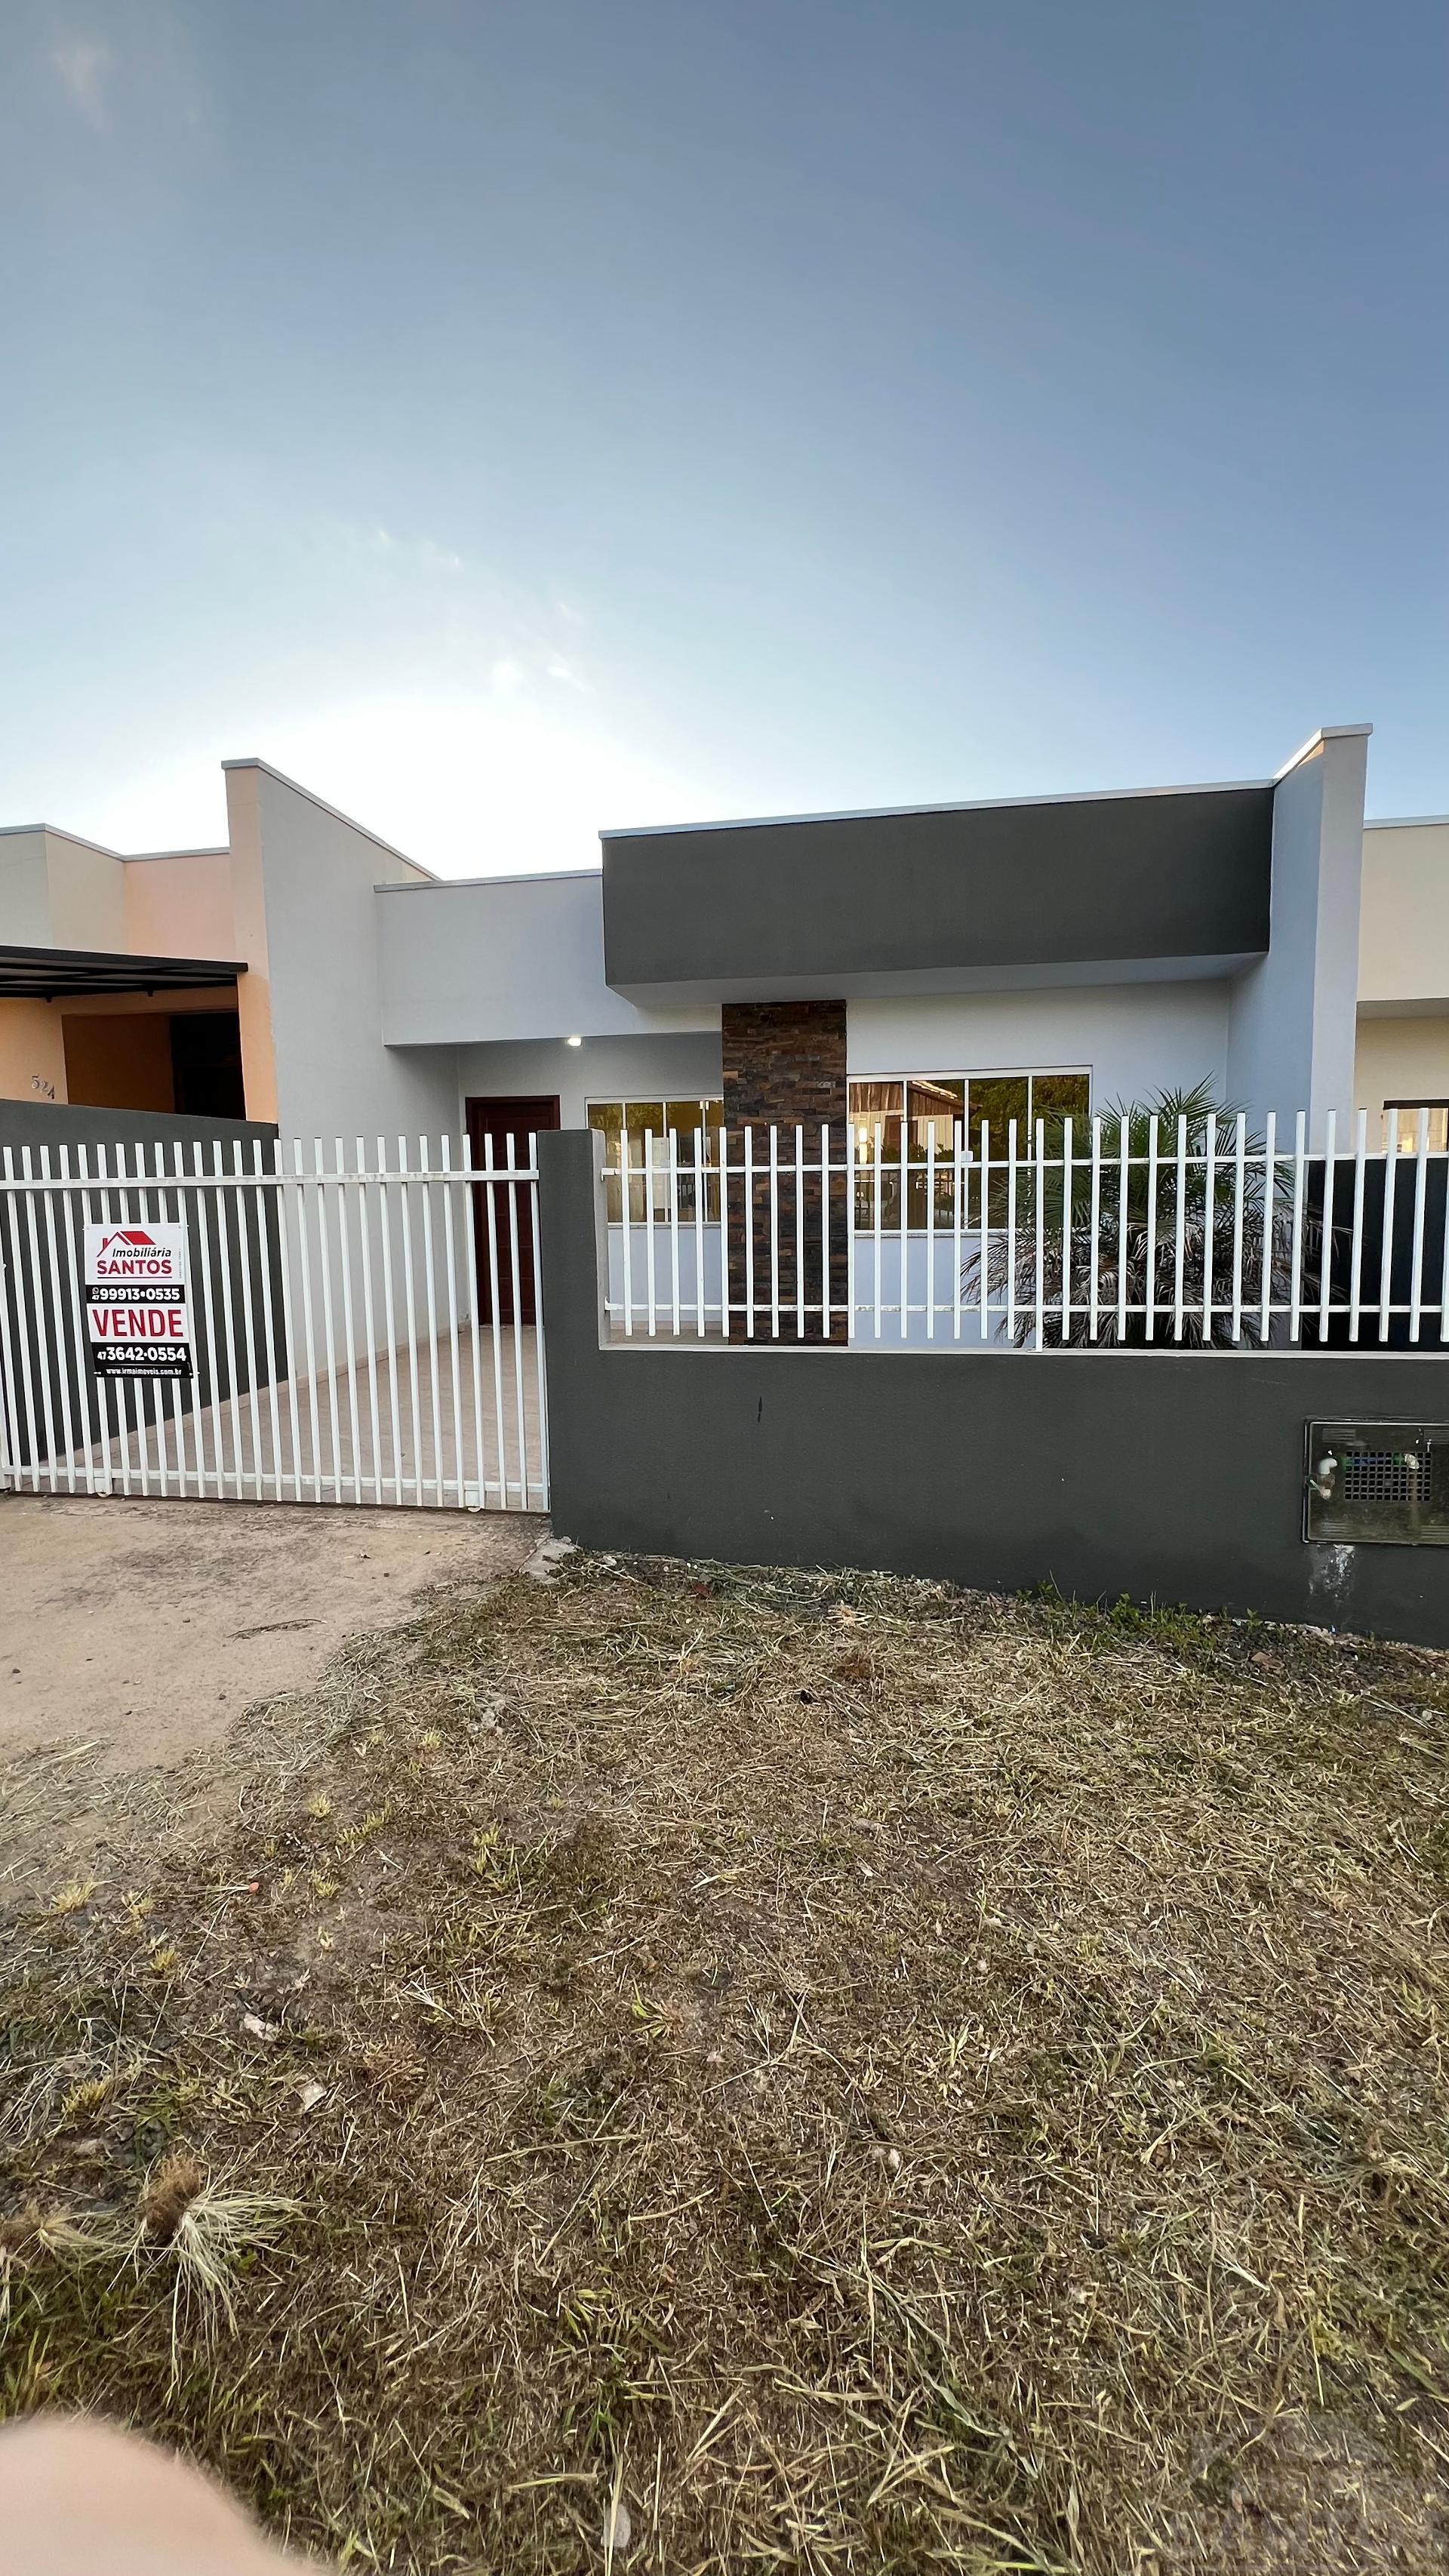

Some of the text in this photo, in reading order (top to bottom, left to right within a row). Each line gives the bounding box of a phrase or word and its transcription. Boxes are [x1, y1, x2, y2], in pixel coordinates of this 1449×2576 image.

[31, 1074, 55, 1100] 524
[112, 1247, 171, 1258] Imobiliária
[97, 1260, 172, 1275] SANTOS
[92, 1309, 184, 1337] VENDE
[97, 1351, 106, 1361] 47
